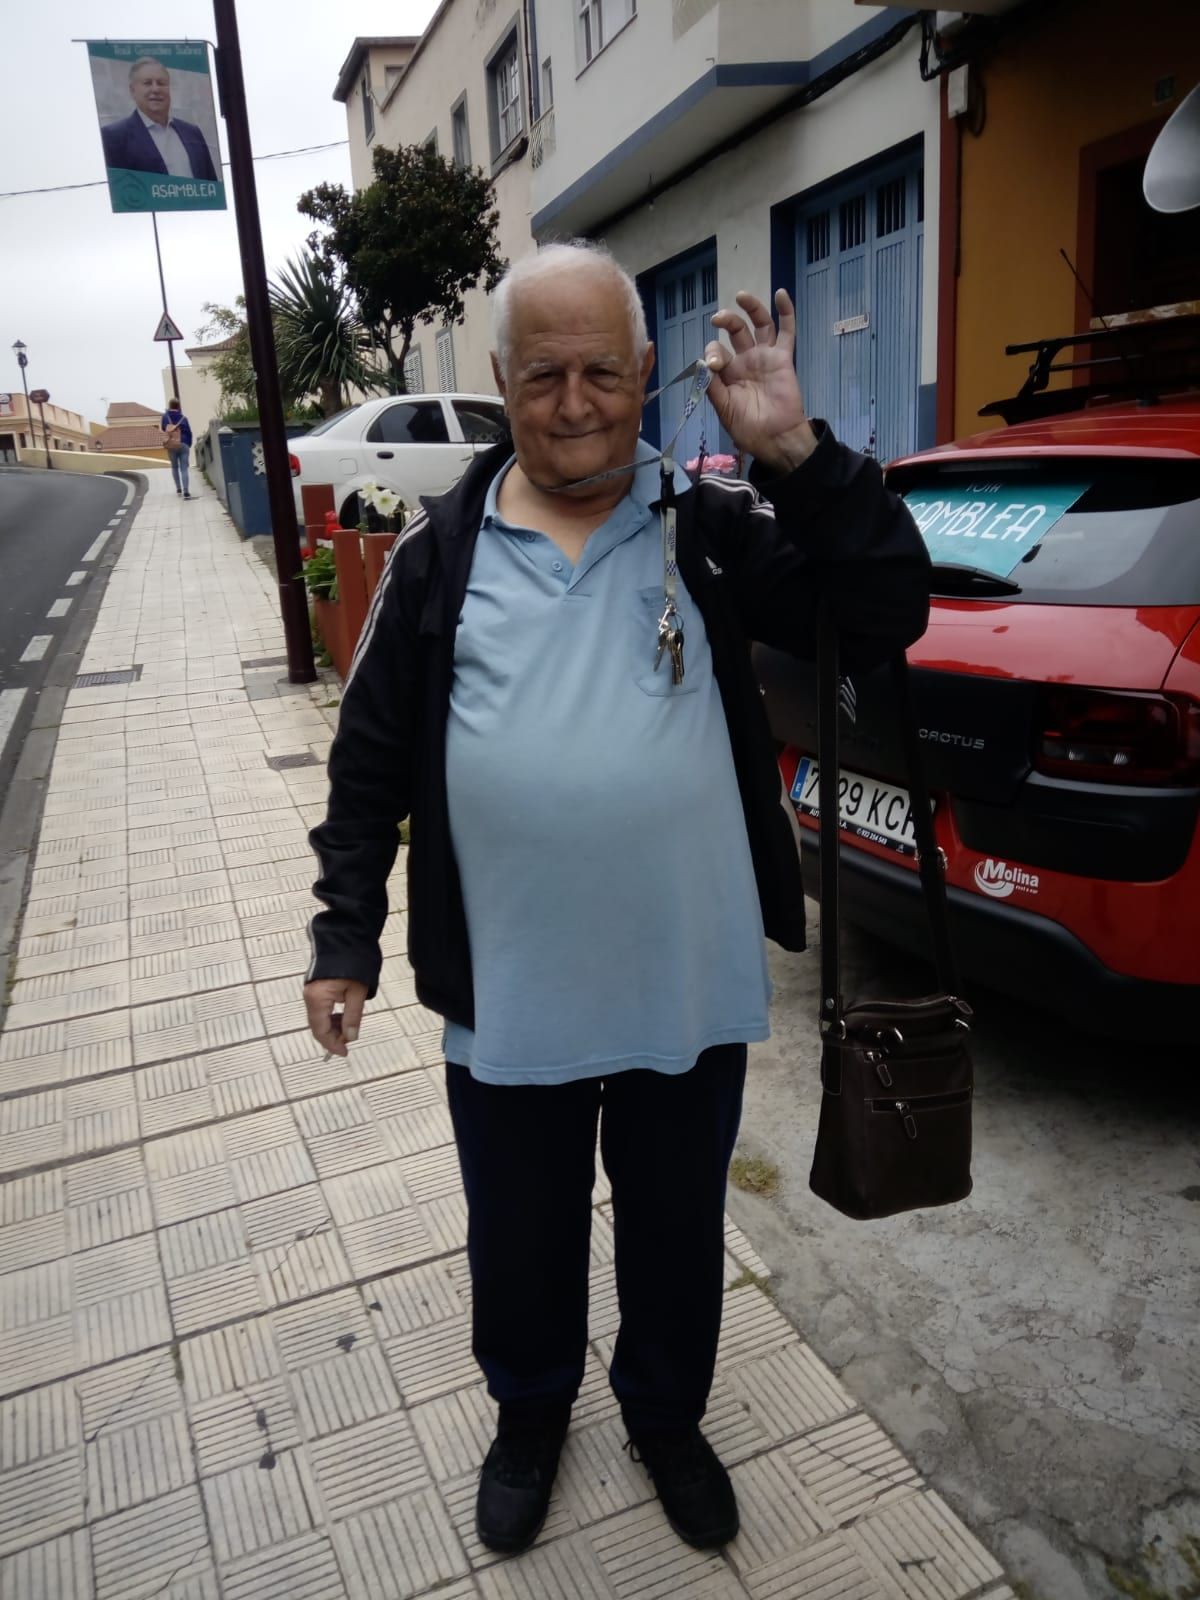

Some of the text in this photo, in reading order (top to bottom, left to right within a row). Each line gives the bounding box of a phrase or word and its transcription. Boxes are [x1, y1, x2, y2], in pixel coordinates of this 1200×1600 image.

[151, 183, 217, 198] ASAMBLEA
[919, 728, 985, 749] CACTUS
[805, 767, 863, 816] 729
[983, 859, 1040, 887] Molina
